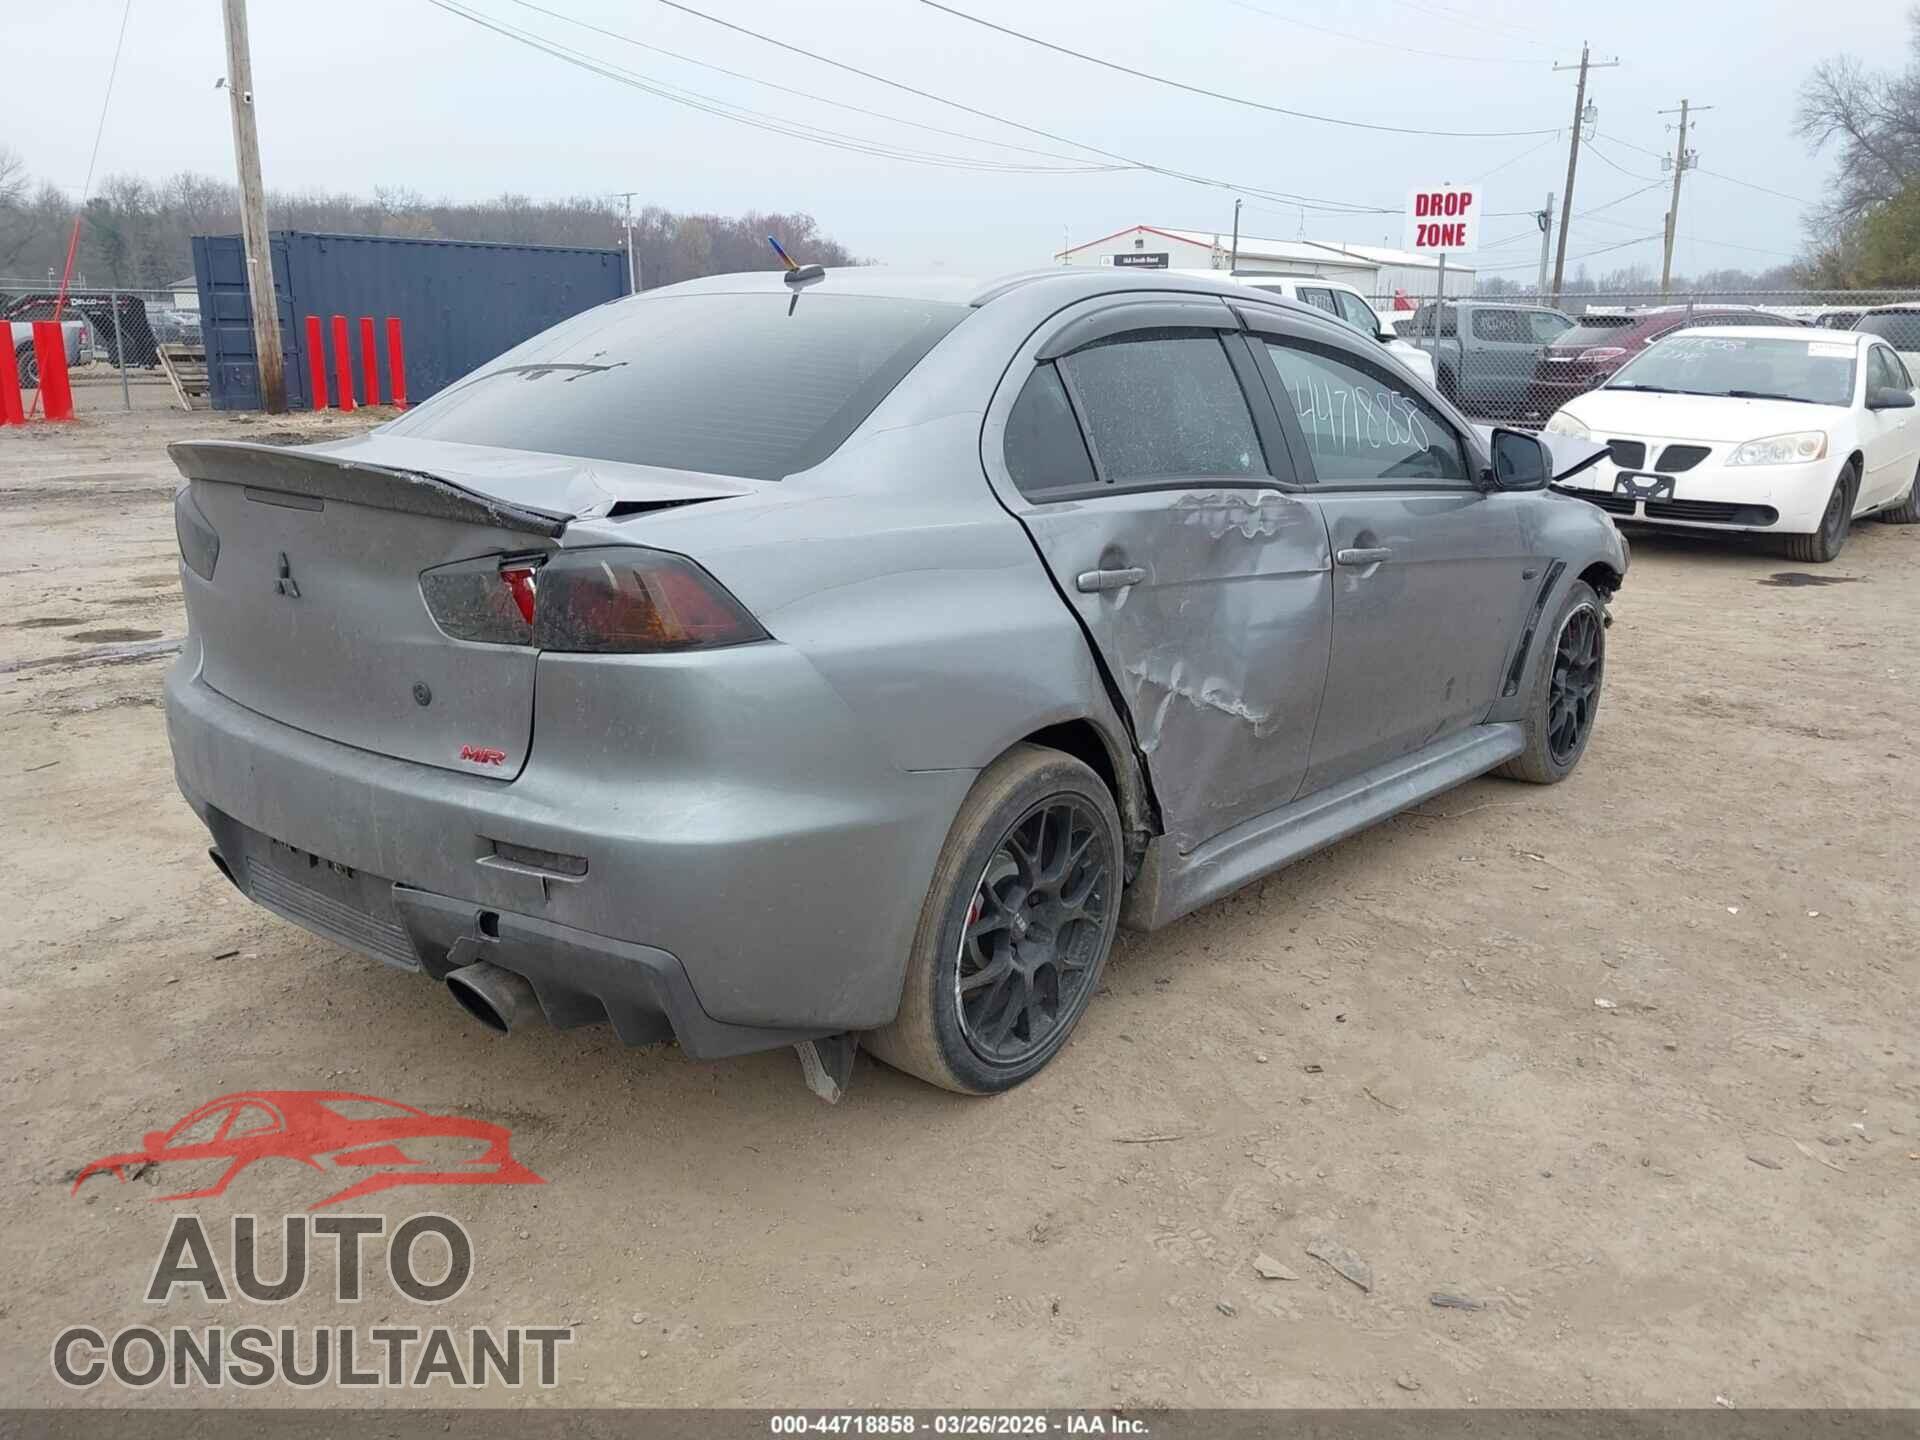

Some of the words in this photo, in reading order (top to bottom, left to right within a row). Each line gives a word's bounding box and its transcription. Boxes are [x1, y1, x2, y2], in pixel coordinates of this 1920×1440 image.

[1416, 192, 1472, 217] DROP
[1416, 223, 1466, 247] ZONE
[1296, 376, 1430, 453] 44718858
